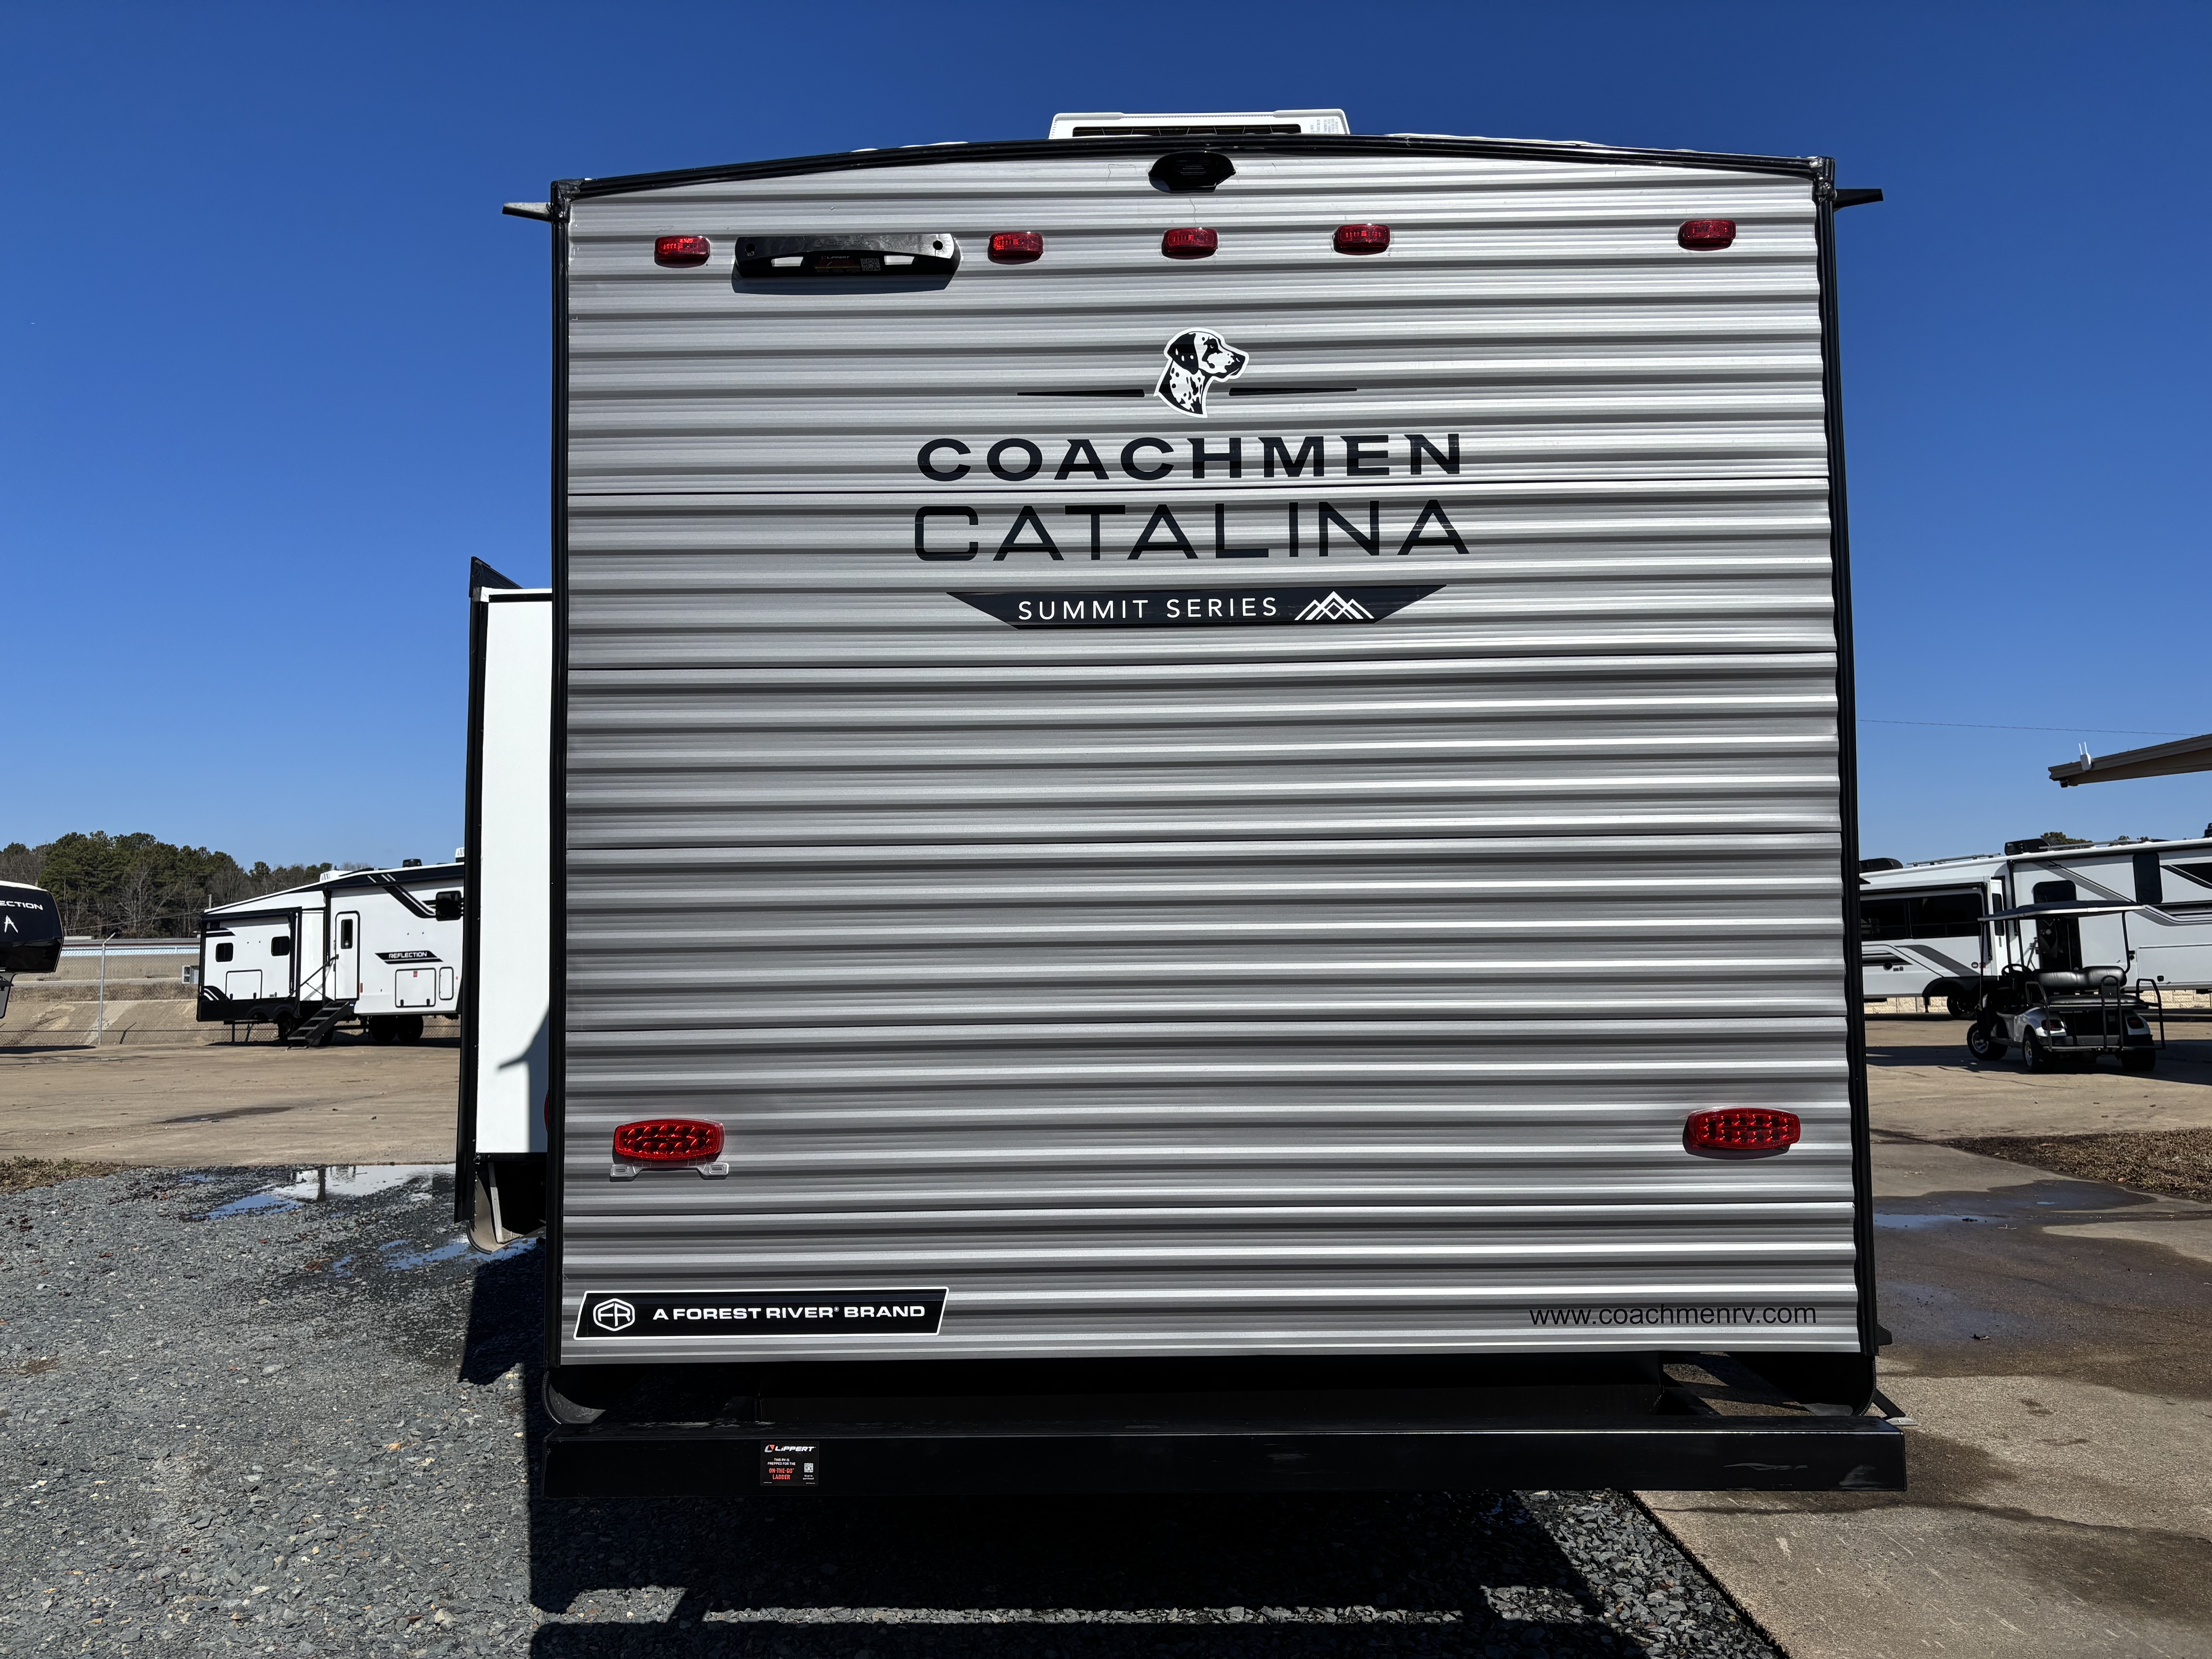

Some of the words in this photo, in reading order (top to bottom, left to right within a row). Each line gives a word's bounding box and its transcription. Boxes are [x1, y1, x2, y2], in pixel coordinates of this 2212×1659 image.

[917, 433, 1461, 481] COACHMEN
[914, 499, 1470, 561] CATALINA
[1018, 599, 1149, 620] SUMMIT
[1166, 596, 1277, 617] SERIES
[653, 1307, 669, 1320] A
[673, 1307, 762, 1320] FOREST
[844, 1305, 925, 1318] BRAND
[1529, 1303, 1817, 1325] www.coachmenrv.com
